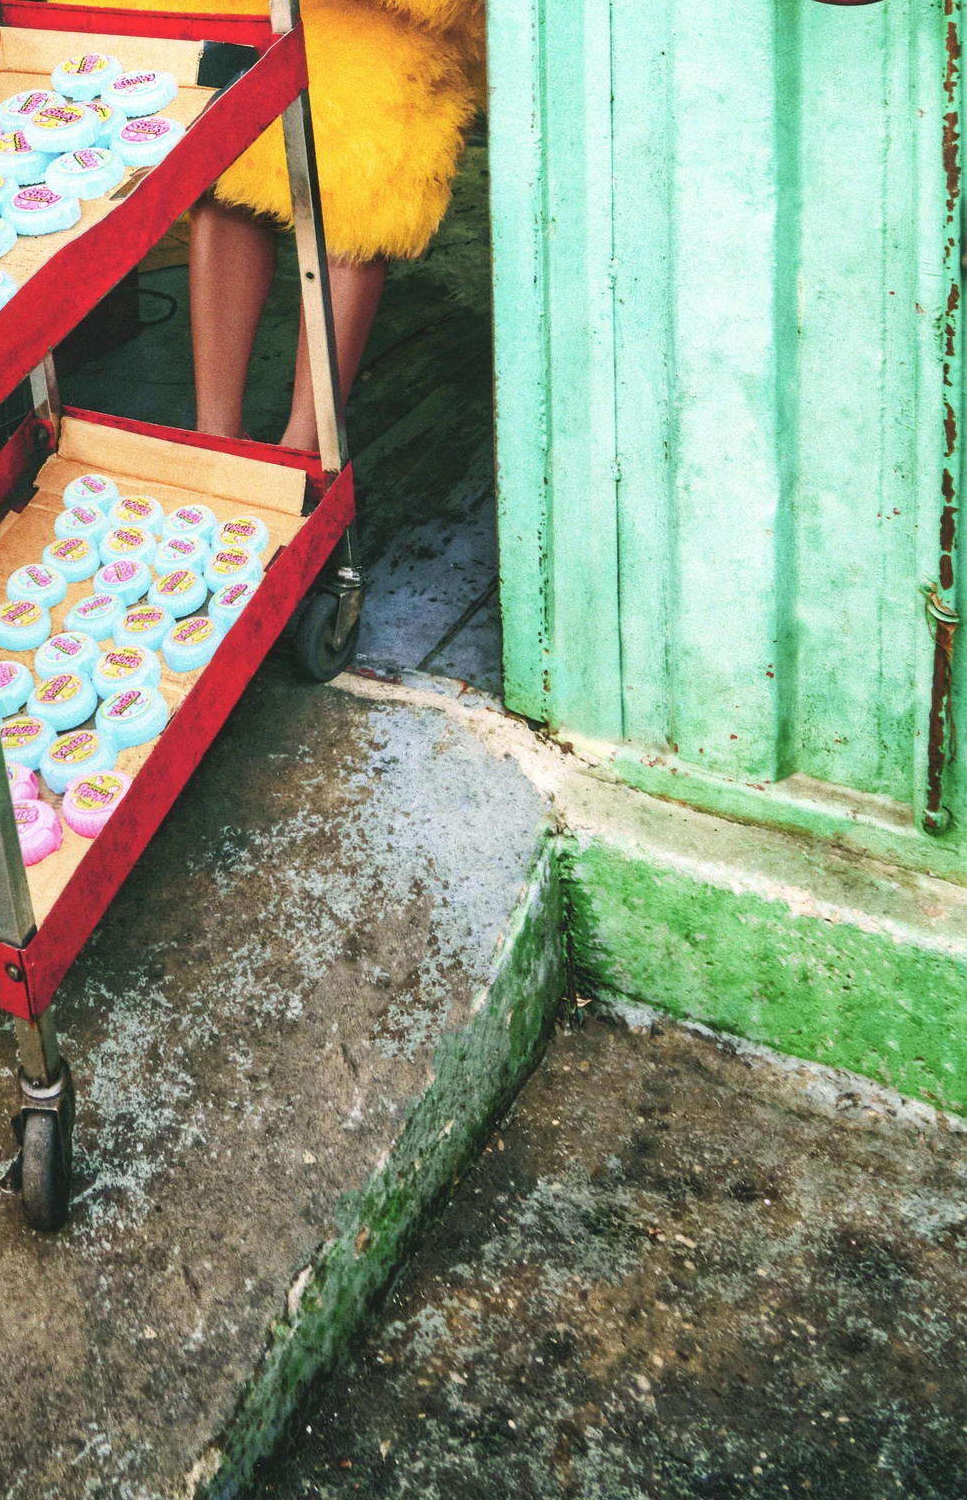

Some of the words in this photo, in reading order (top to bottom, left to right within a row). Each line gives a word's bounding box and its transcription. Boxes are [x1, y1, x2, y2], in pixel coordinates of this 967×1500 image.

[113, 73, 156, 90] Sticky
[40, 107, 81, 122] Sticky
[125, 120, 170, 135] Sticky
